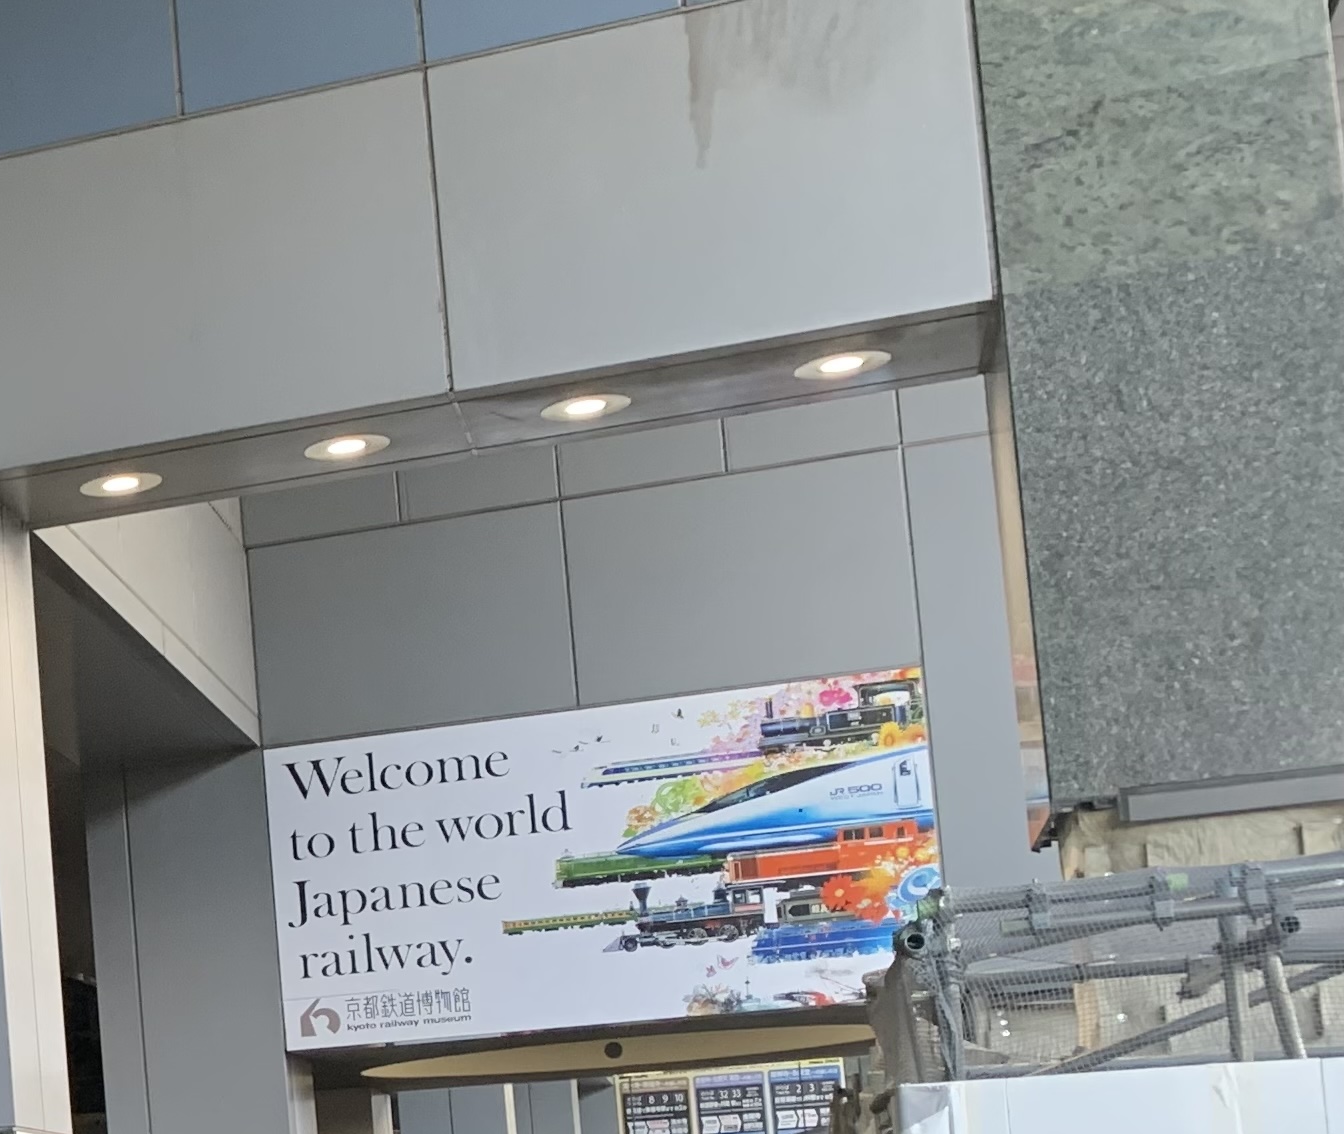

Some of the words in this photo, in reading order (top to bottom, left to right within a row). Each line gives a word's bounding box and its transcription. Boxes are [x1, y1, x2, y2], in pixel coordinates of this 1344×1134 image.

[282, 750, 510, 800] Welcome
[829, 787, 845, 796] JR
[847, 783, 883, 793] 500
[290, 828, 335, 861] to
[349, 811, 425, 854] the
[435, 790, 572, 844] world
[288, 873, 503, 928] Japanese
[300, 933, 473, 980] railway.
[345, 987, 472, 1021] 京都鉄道博物館
[346, 1022, 377, 1032] kyoto
[380, 1018, 420, 1030] railway
[423, 1014, 472, 1025] museum
[674, 1093, 684, 1103] 10
[719, 1090, 729, 1099] 32
